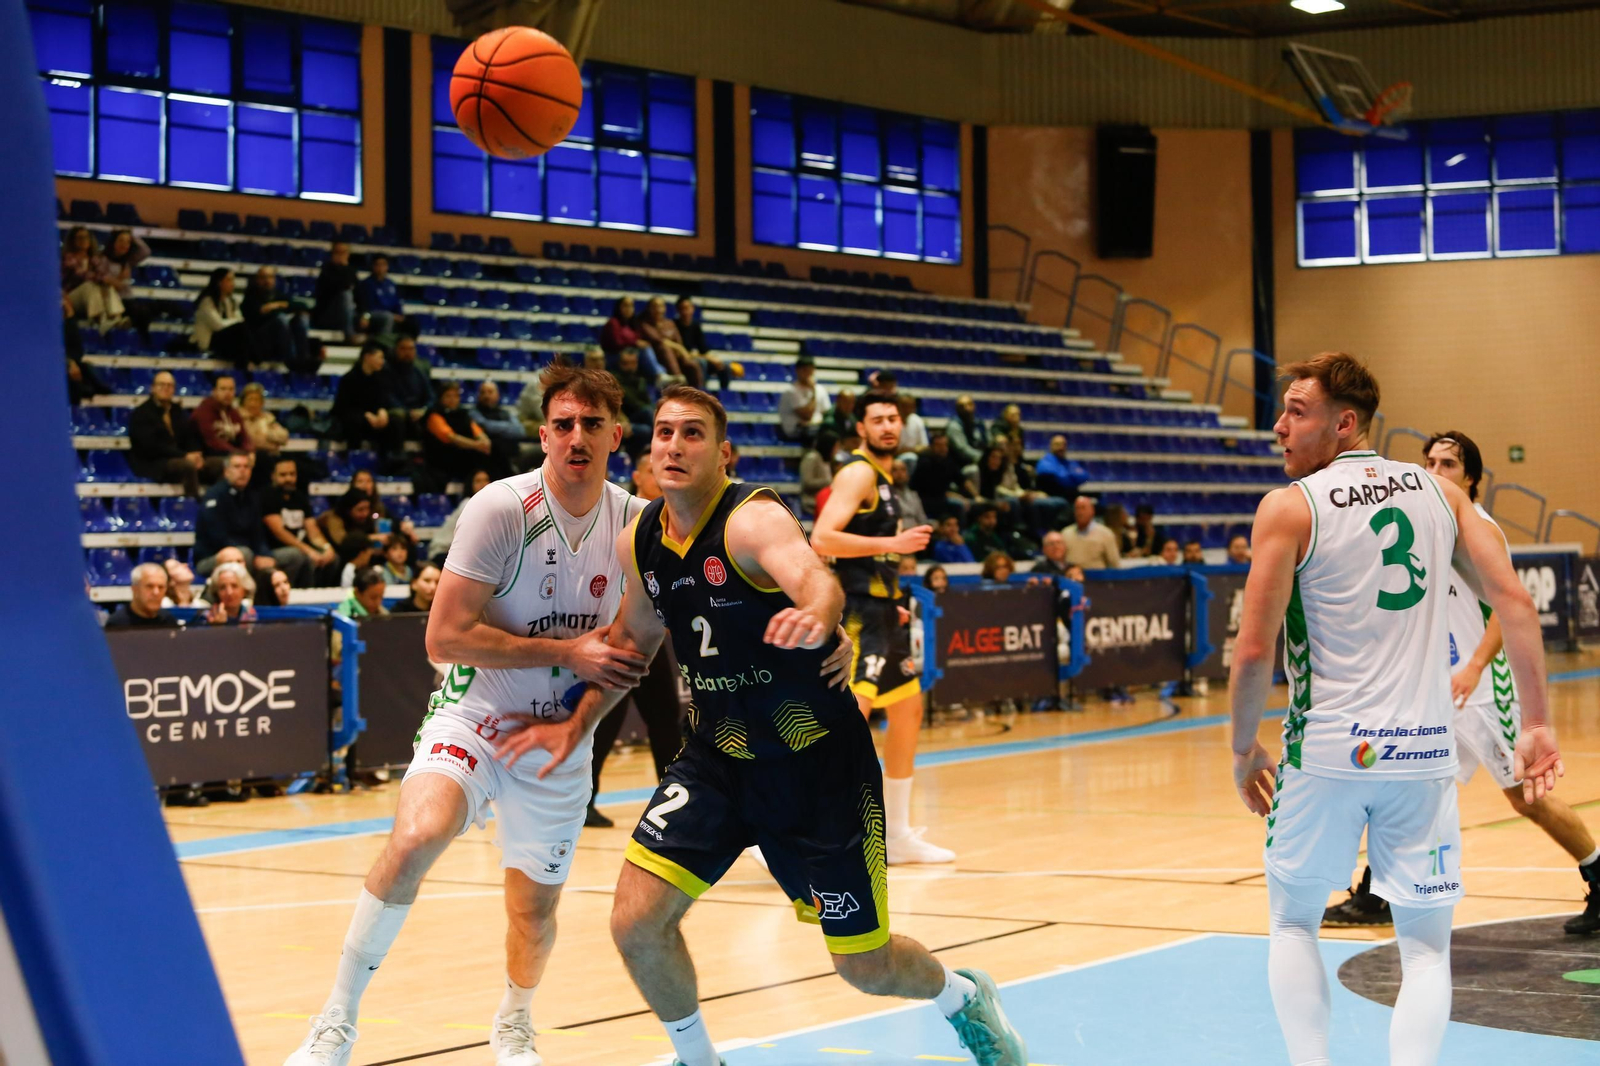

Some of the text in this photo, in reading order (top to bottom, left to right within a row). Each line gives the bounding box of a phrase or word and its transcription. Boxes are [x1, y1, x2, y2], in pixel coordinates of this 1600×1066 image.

[1329, 471, 1424, 509] CARDACI
[1369, 506, 1427, 611] 3
[691, 615, 720, 658] 2
[1085, 613, 1174, 646] CENTRAL
[146, 715, 272, 744] CENTER
[1350, 722, 1448, 738] Instalaciones
[1379, 745, 1450, 761] Zornotza
[645, 782, 690, 830] 2
